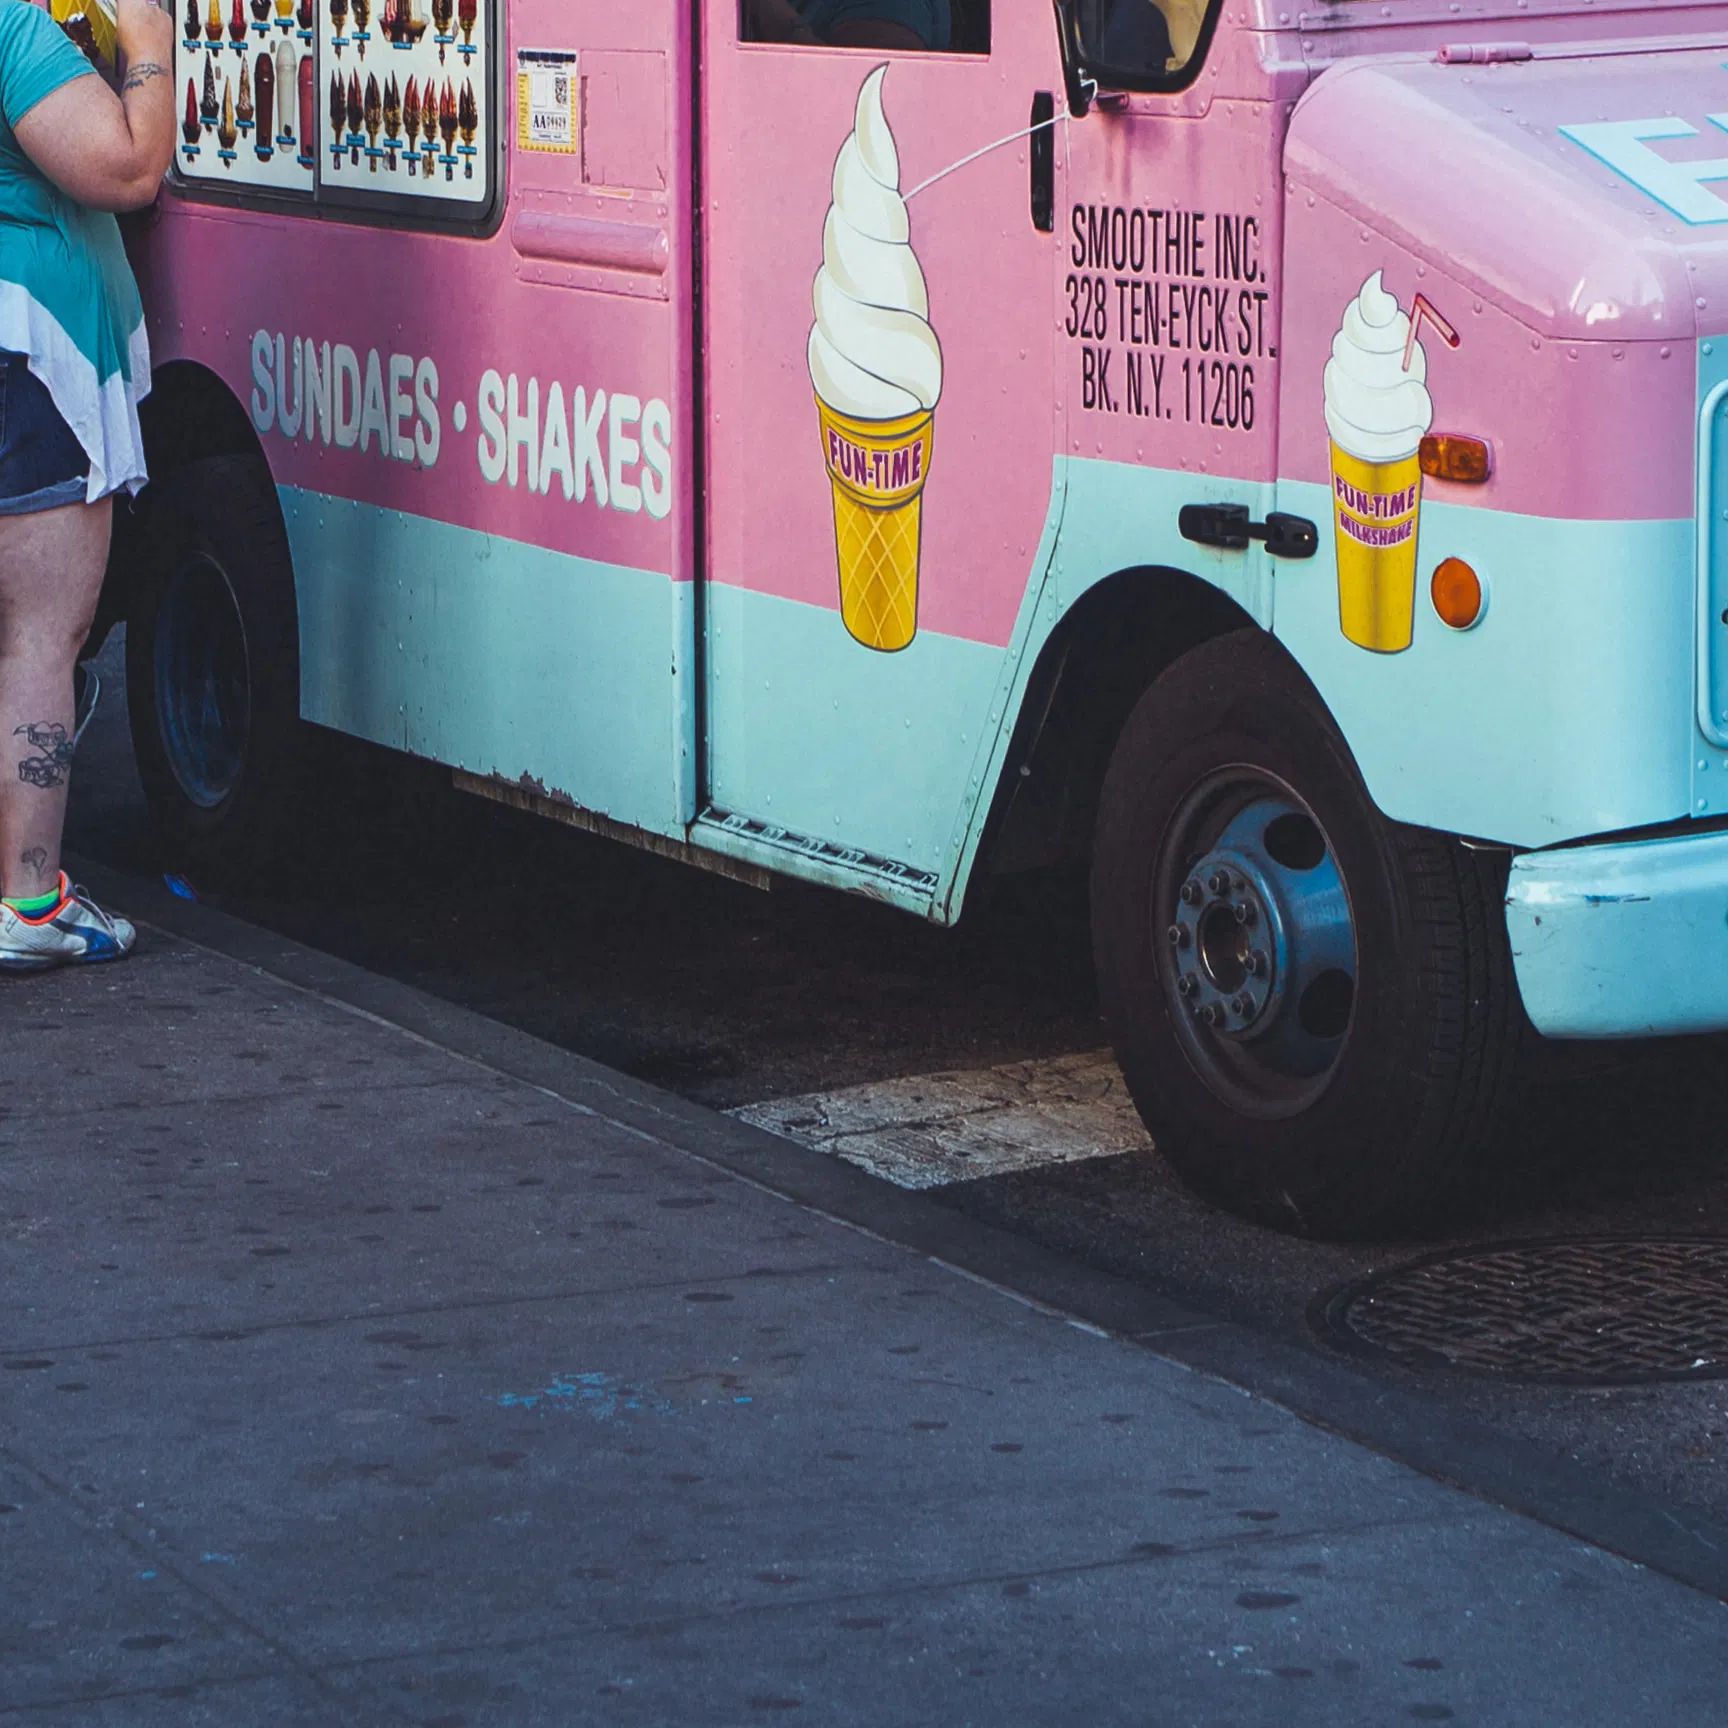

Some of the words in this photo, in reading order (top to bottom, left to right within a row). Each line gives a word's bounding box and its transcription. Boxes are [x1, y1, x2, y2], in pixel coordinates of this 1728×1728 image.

[1071, 203, 1205, 277] SMOOTHIE
[1214, 213, 1266, 283] INC.
[1065, 274, 1107, 340] 328
[1114, 278, 1229, 353] TEN-EYCK
[1237, 290, 1277, 358] ST.
[250, 328, 442, 469] SUNDAES
[477, 368, 672, 521] SHAKES
[1082, 346, 1119, 413] BK.
[1126, 351, 1172, 420] N.Y.
[1182, 357, 1255, 432] 11206
[1340, 512, 1412, 546] MILKSHAKE
